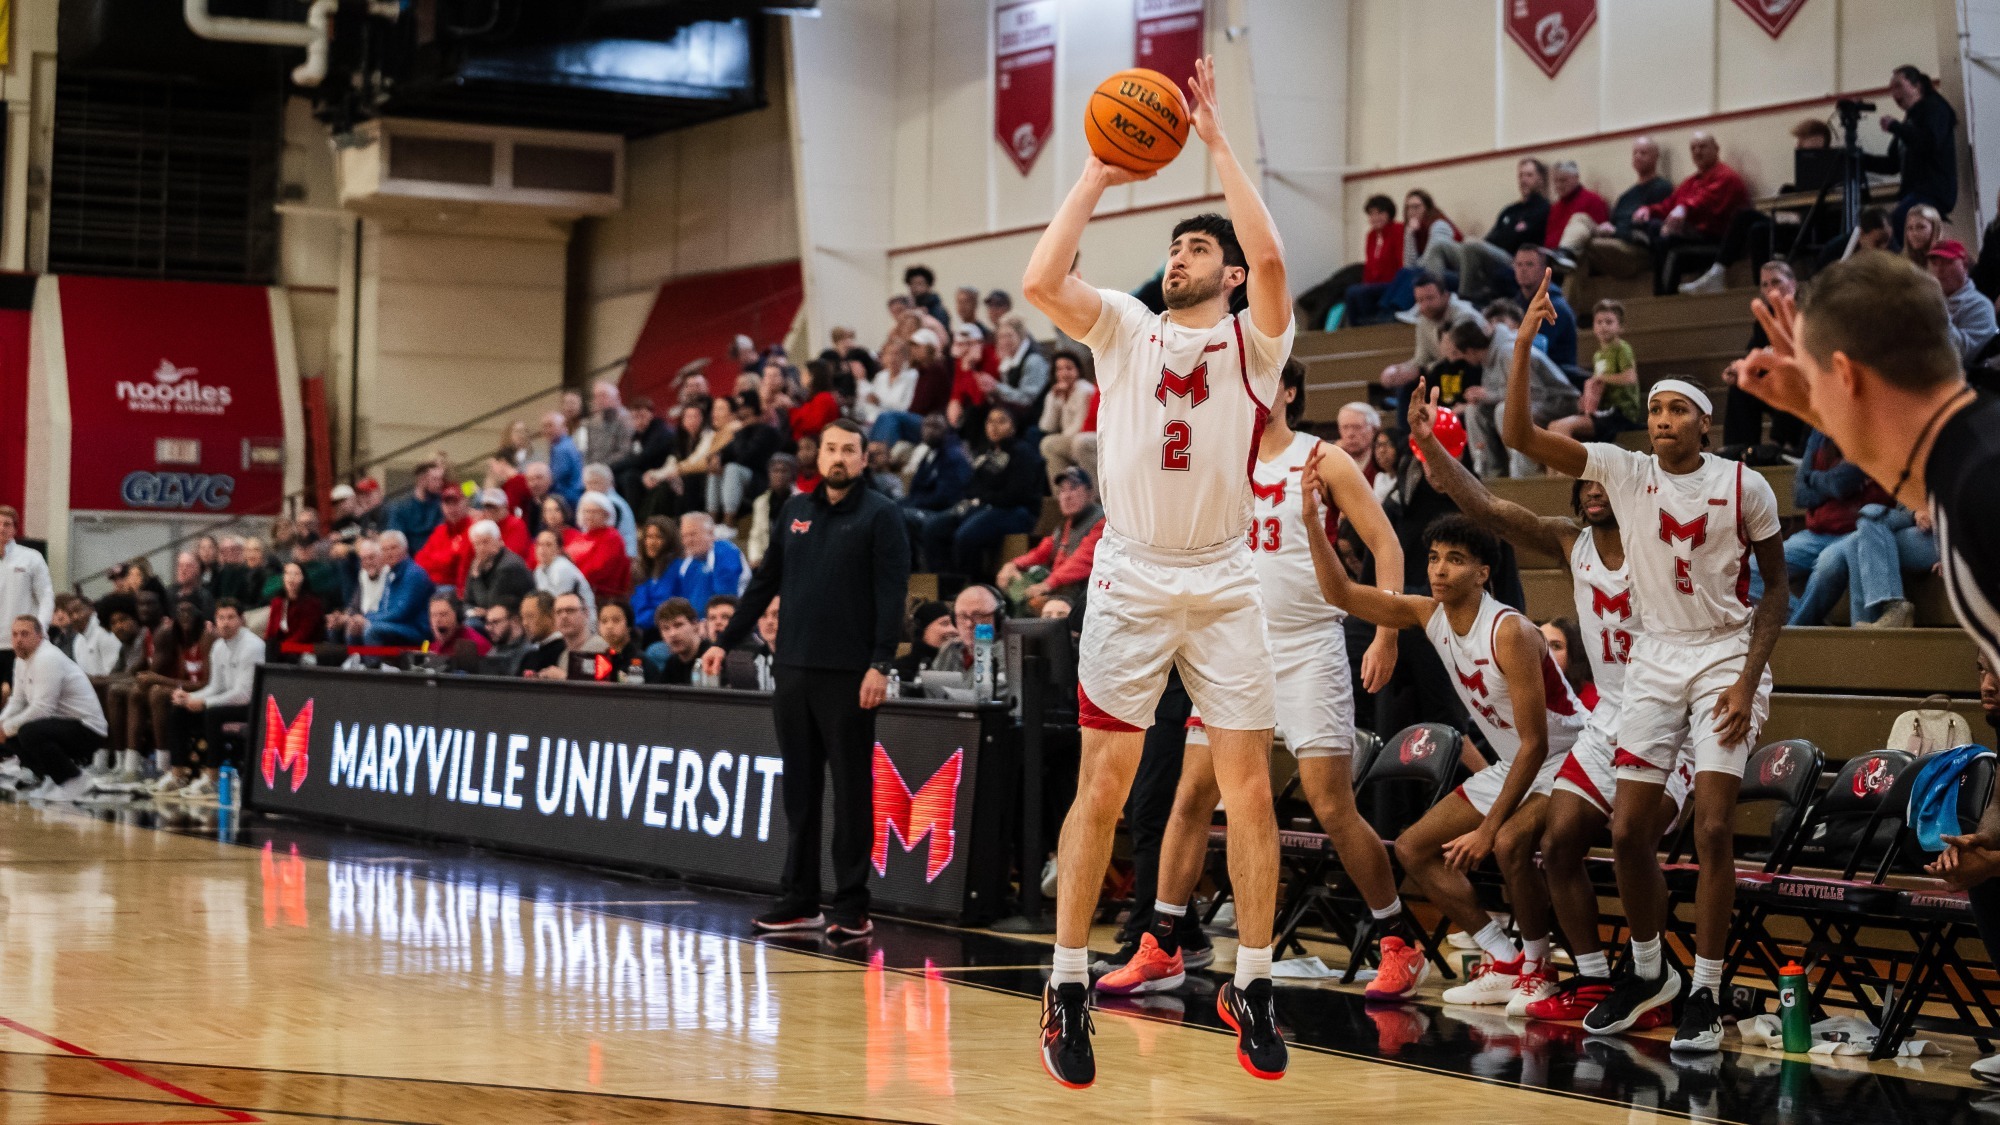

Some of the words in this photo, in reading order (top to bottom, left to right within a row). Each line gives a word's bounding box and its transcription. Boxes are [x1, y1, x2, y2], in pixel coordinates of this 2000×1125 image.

[1119, 80, 1179, 130] Wilson
[1110, 113, 1156, 149] NCAA
[116, 379, 232, 406] noodles
[1155, 361, 1209, 409] M
[1161, 420, 1191, 471] 2
[122, 470, 235, 509] GLVC
[1659, 507, 1708, 551] M
[1675, 556, 1694, 595] 5
[1589, 583, 1632, 623] M
[1600, 628, 1633, 665] 13
[329, 720, 529, 810] MARYVILLE
[535, 736, 783, 841] UNIVERSIT
[1778, 883, 1845, 901] MARYVILLE
[1780, 987, 1796, 1008] G
